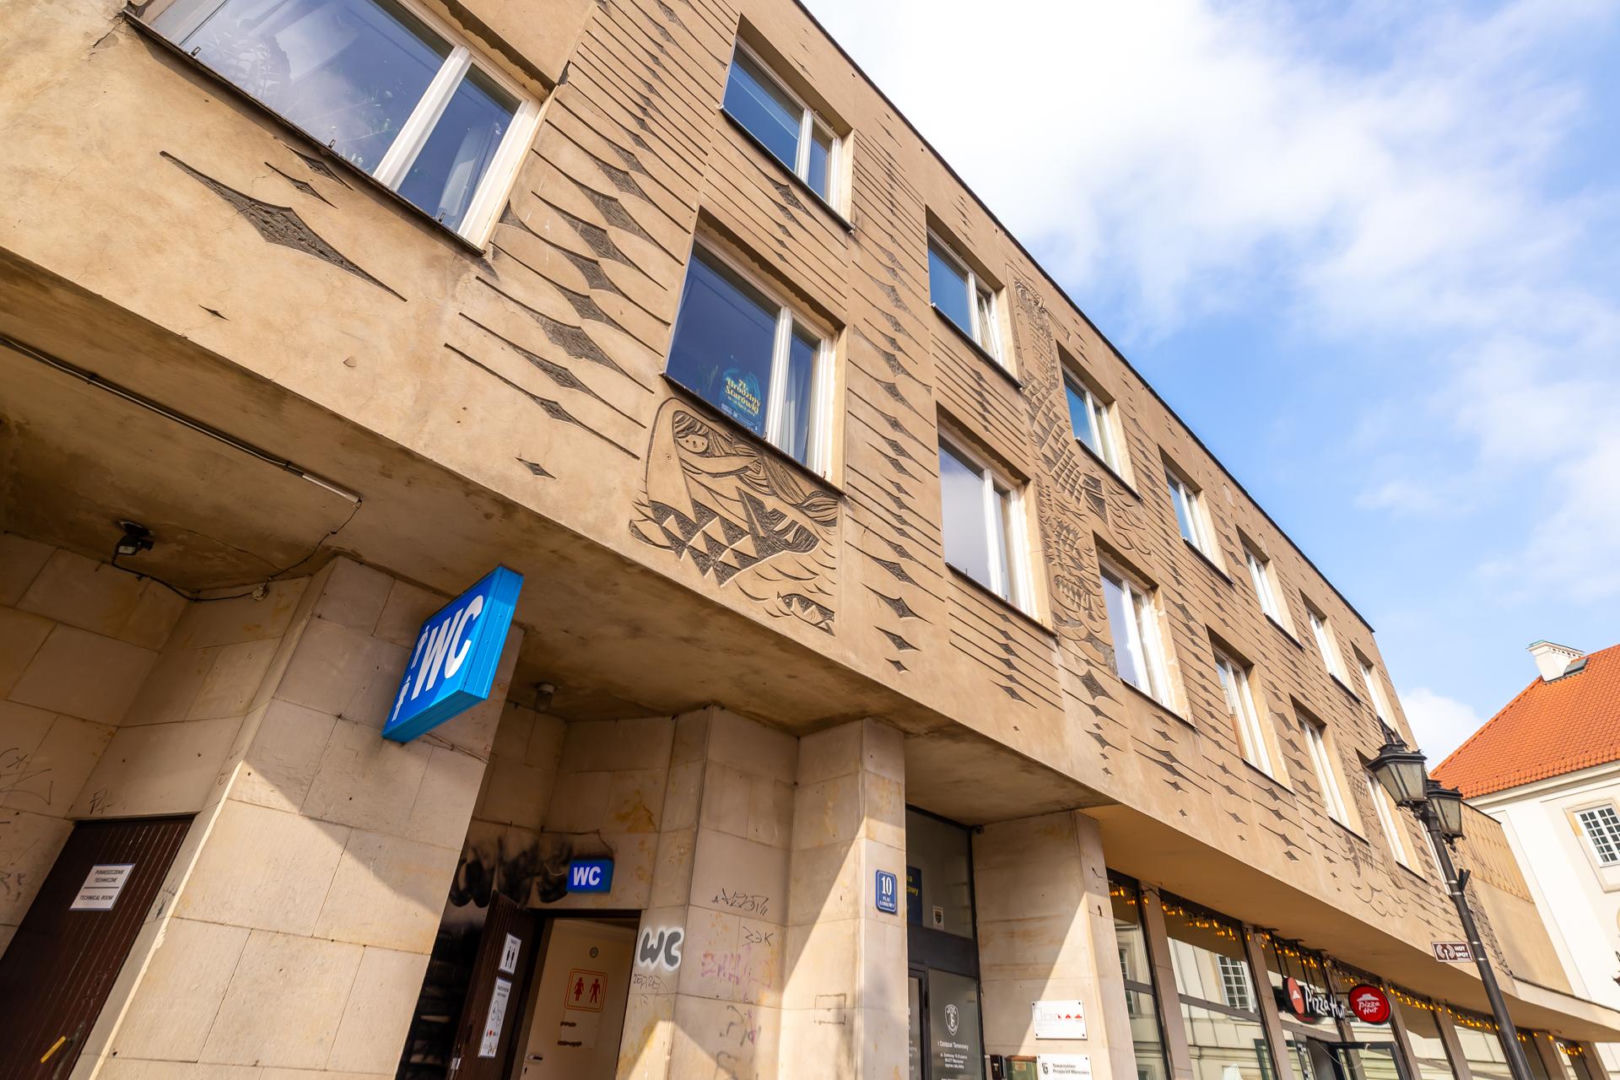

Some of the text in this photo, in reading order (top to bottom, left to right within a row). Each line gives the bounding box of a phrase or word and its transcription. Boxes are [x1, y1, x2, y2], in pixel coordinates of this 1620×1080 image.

[411, 595, 484, 700] WC
[573, 866, 601, 886] WC
[881, 876, 892, 896] 10
[638, 928, 684, 970] WC
[1304, 984, 1346, 1019] Pizza Hut
[1358, 1000, 1381, 1012] Pizza
[1362, 1007, 1379, 1016] Hut
